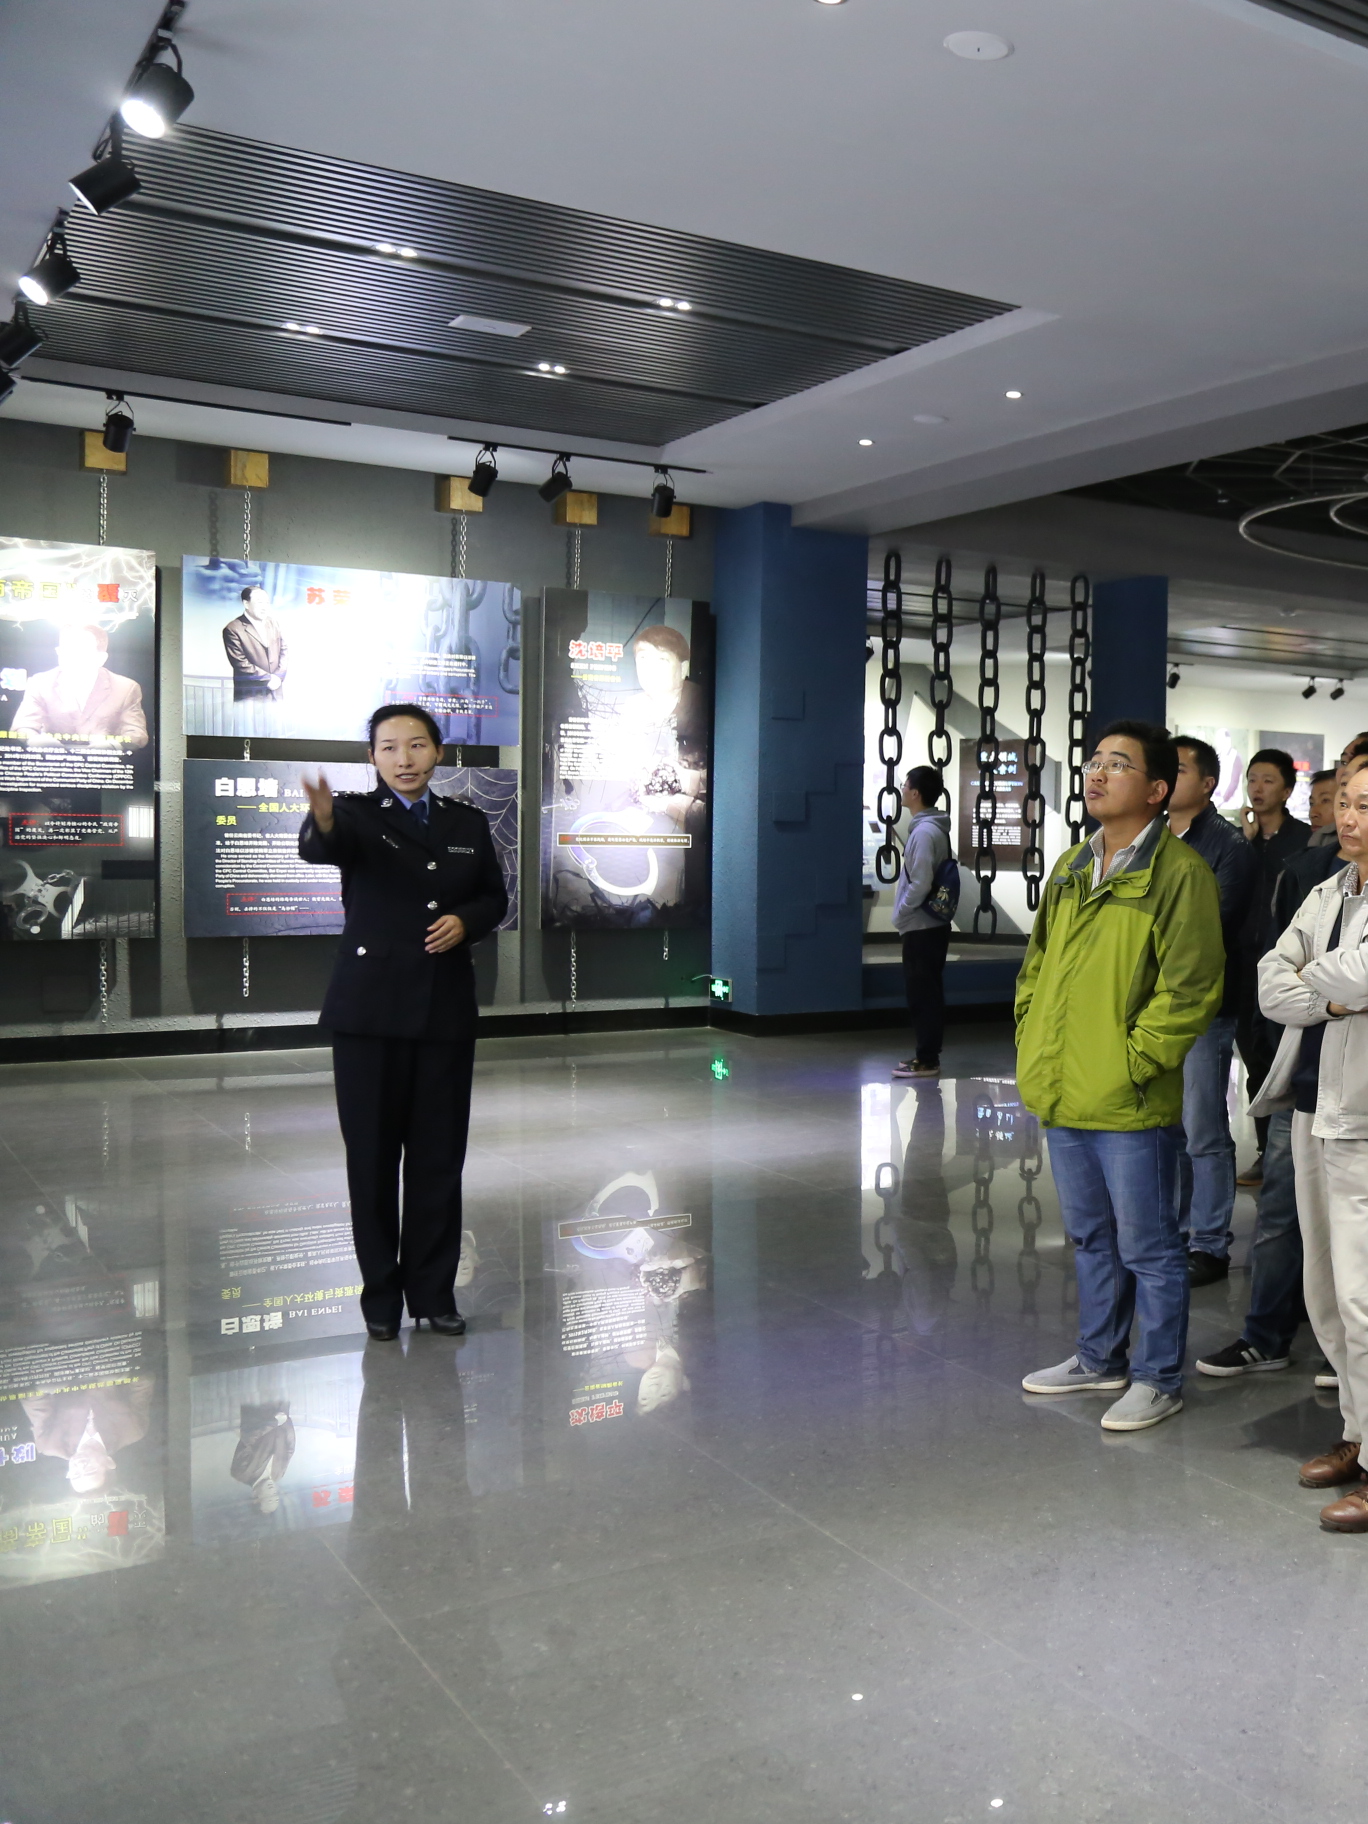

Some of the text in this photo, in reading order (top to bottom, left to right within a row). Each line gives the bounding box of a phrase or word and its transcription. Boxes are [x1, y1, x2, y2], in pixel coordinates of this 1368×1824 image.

[569, 640, 624, 662] 沈培平
[216, 815, 237, 826] 委员
